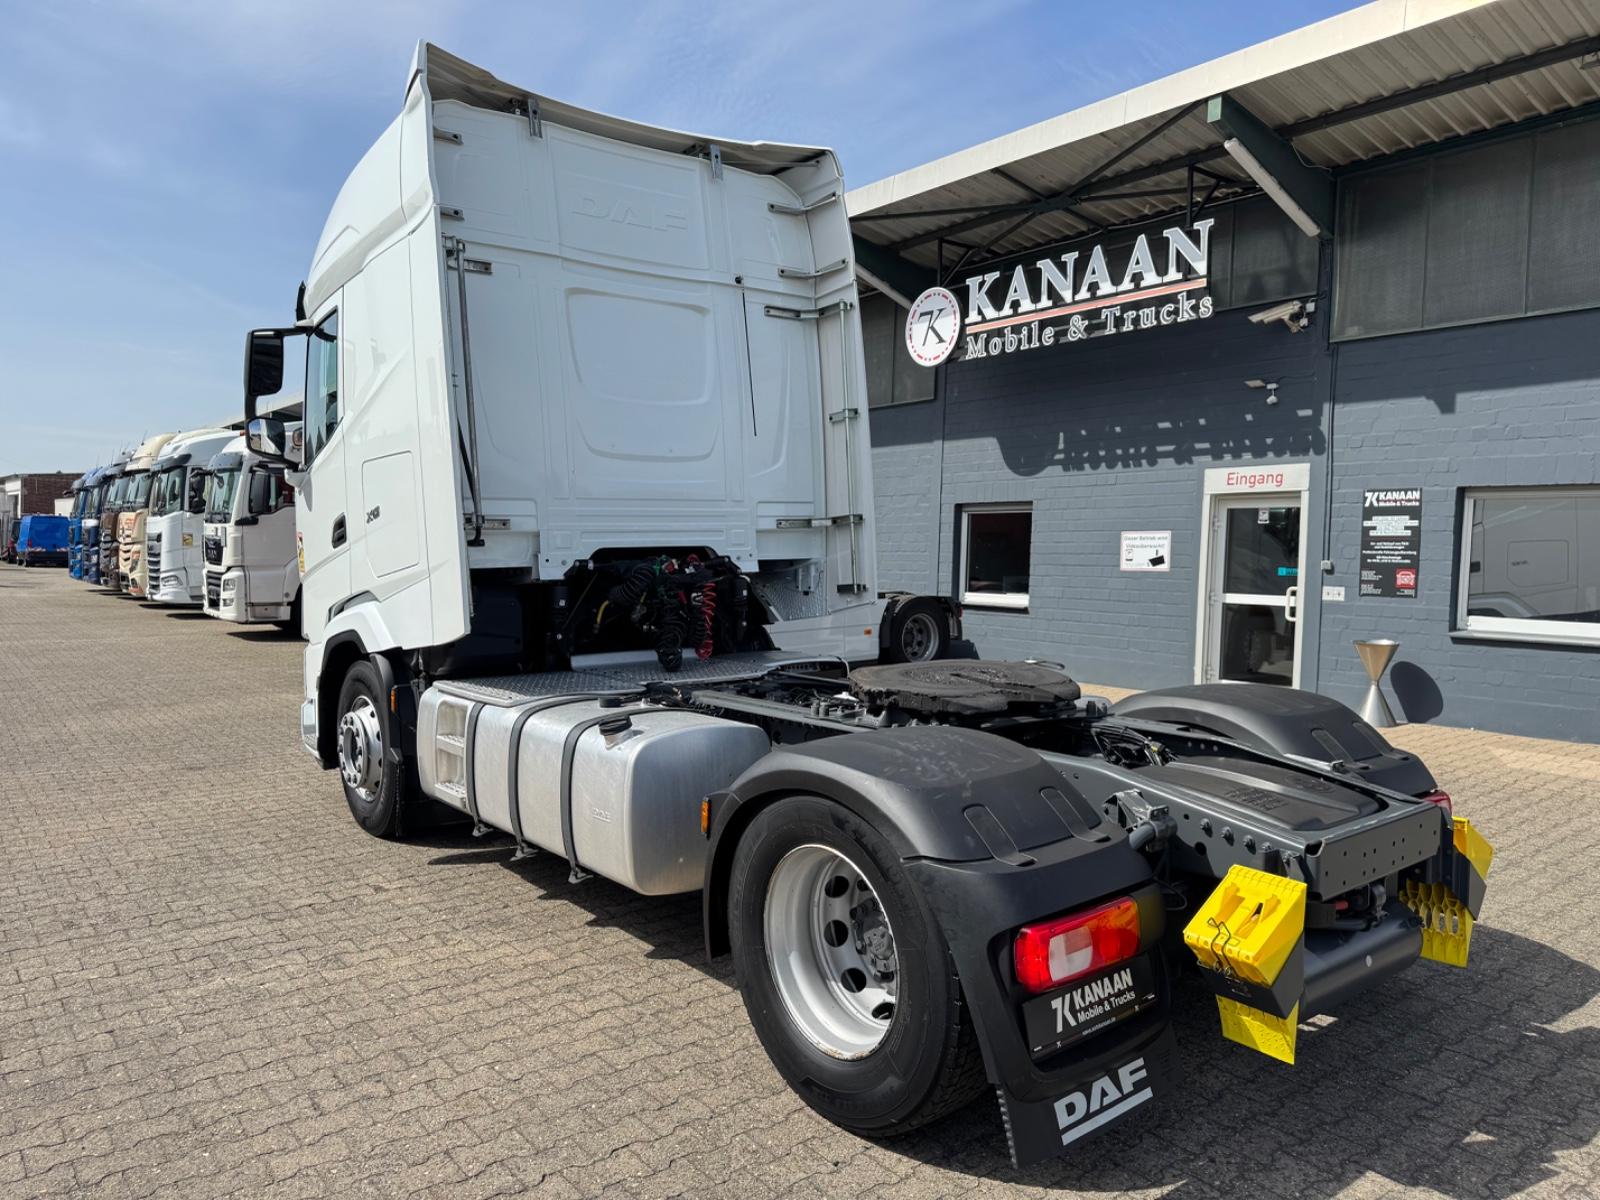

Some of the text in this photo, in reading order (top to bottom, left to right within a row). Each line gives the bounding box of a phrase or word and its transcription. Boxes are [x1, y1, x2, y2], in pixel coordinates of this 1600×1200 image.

[965, 218, 1214, 324] KANAAN
[966, 291, 1213, 360] Mobile & Trucks
[1227, 471, 1284, 488] Eingang
[1379, 490, 1420, 500] KANAAN
[1072, 968, 1133, 1010] KANAAN
[1077, 990, 1136, 1023] Mobile & Trucks
[1053, 1057, 1147, 1130] DAF
